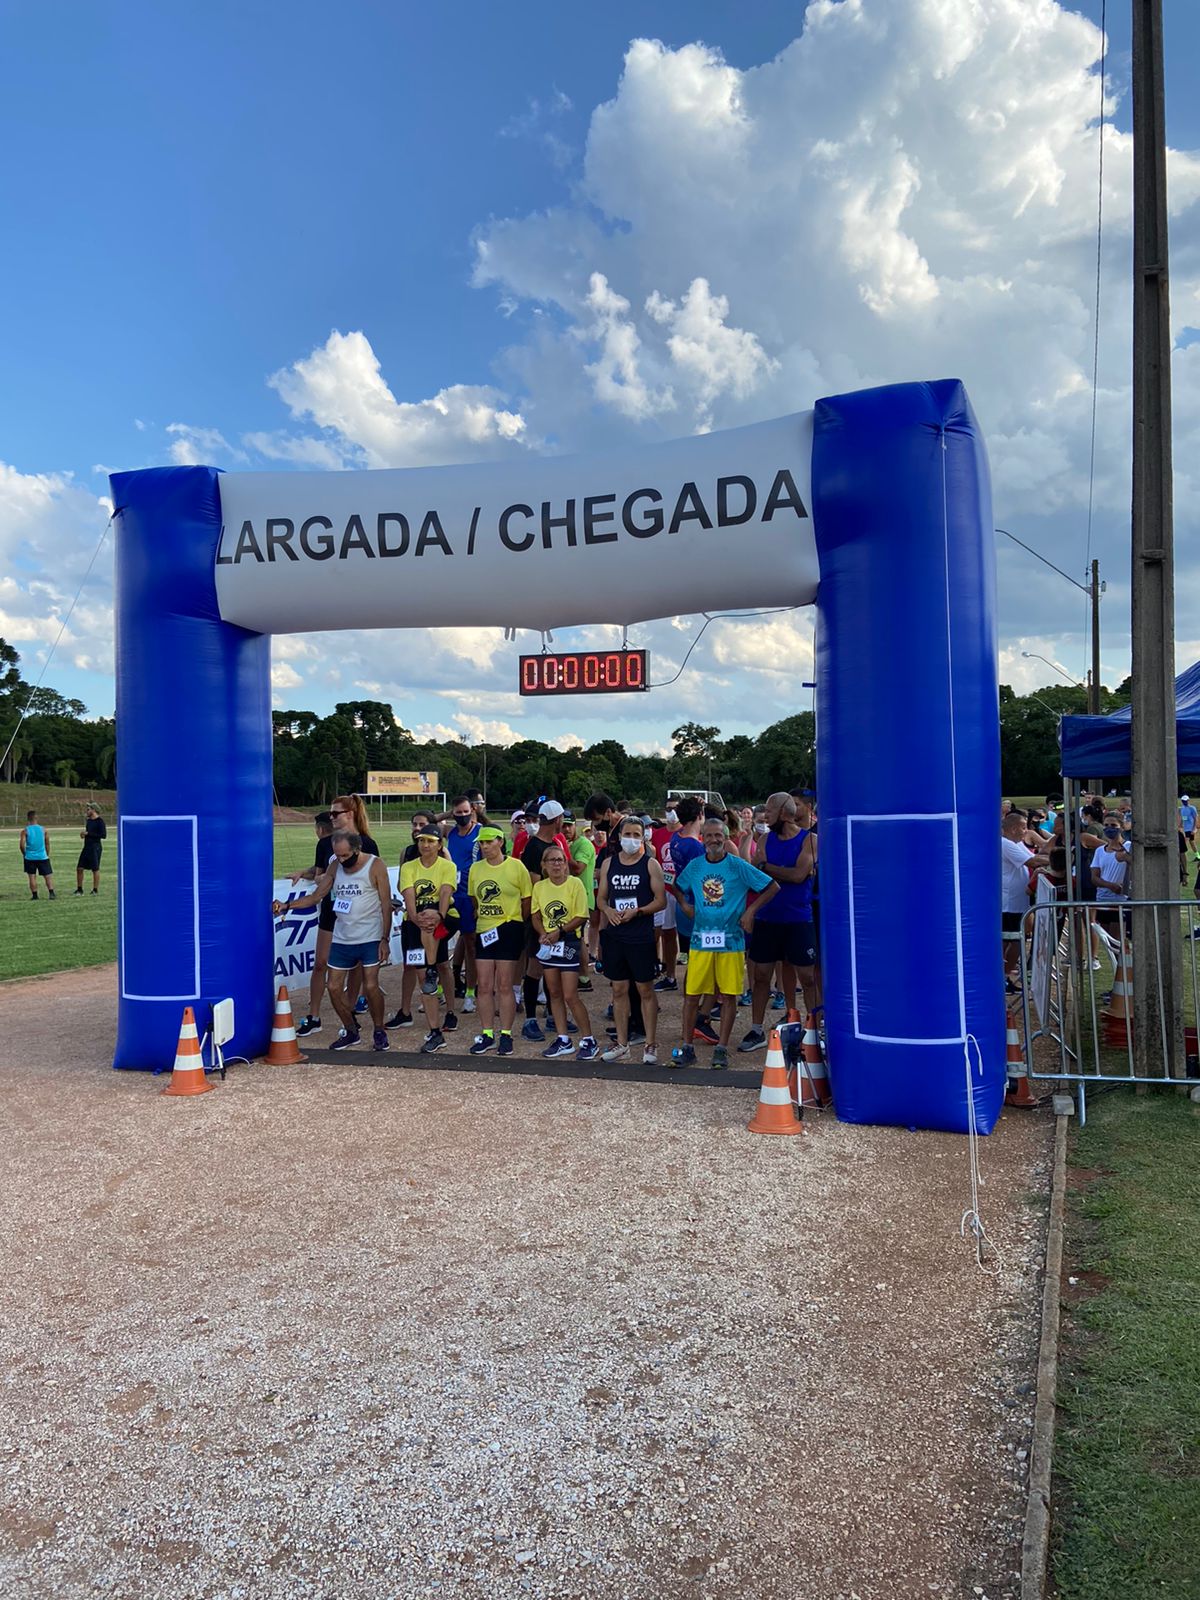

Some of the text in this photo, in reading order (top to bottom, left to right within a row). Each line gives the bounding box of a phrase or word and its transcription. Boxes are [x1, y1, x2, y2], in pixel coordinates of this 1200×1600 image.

[216, 469, 808, 564] LARGADA / CHEGADA
[523, 654, 642, 690] 00:00:00
[611, 874, 641, 886] CWB
[337, 901, 349, 910] 100
[619, 901, 635, 911] 026
[483, 932, 496, 943] 082
[705, 936, 722, 945] 013
[408, 954, 423, 962] 093
